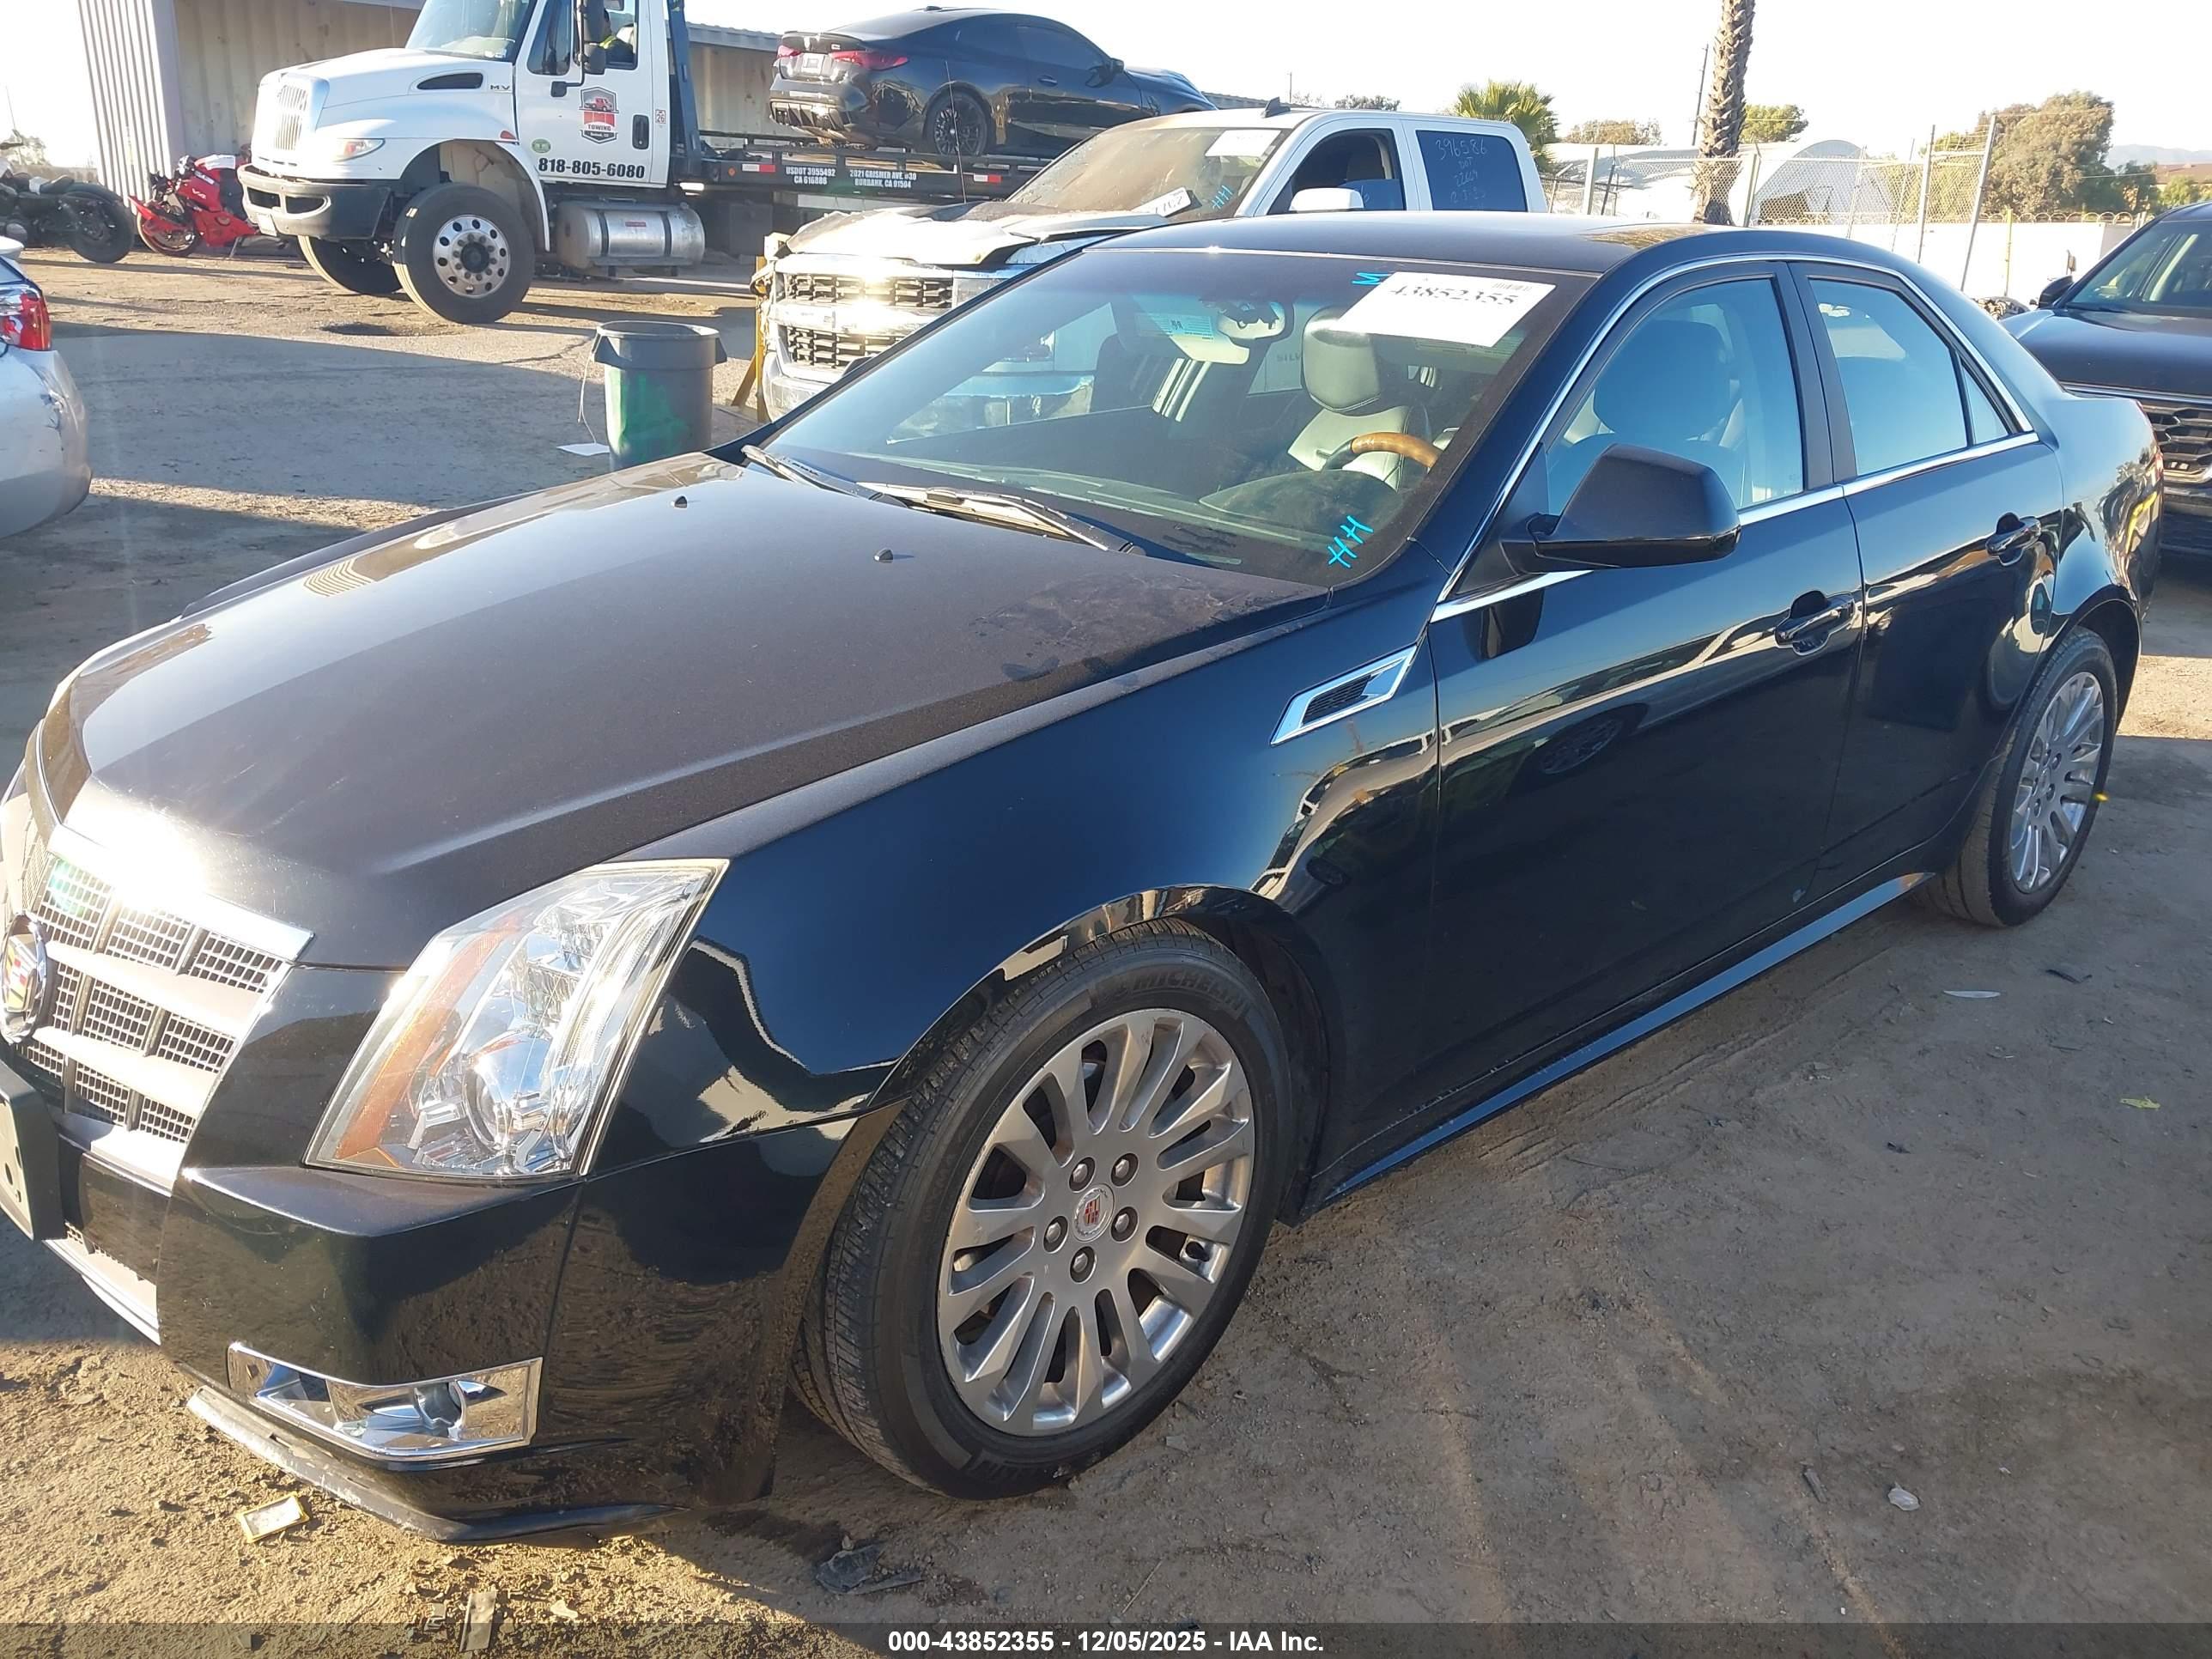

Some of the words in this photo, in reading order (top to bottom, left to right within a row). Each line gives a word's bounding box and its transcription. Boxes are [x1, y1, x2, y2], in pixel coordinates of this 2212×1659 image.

[538, 157, 645, 179] 818-805-6080
[786, 167, 807, 175] USDOT
[849, 169, 864, 178] 2021
[884, 179, 893, 187] CA
